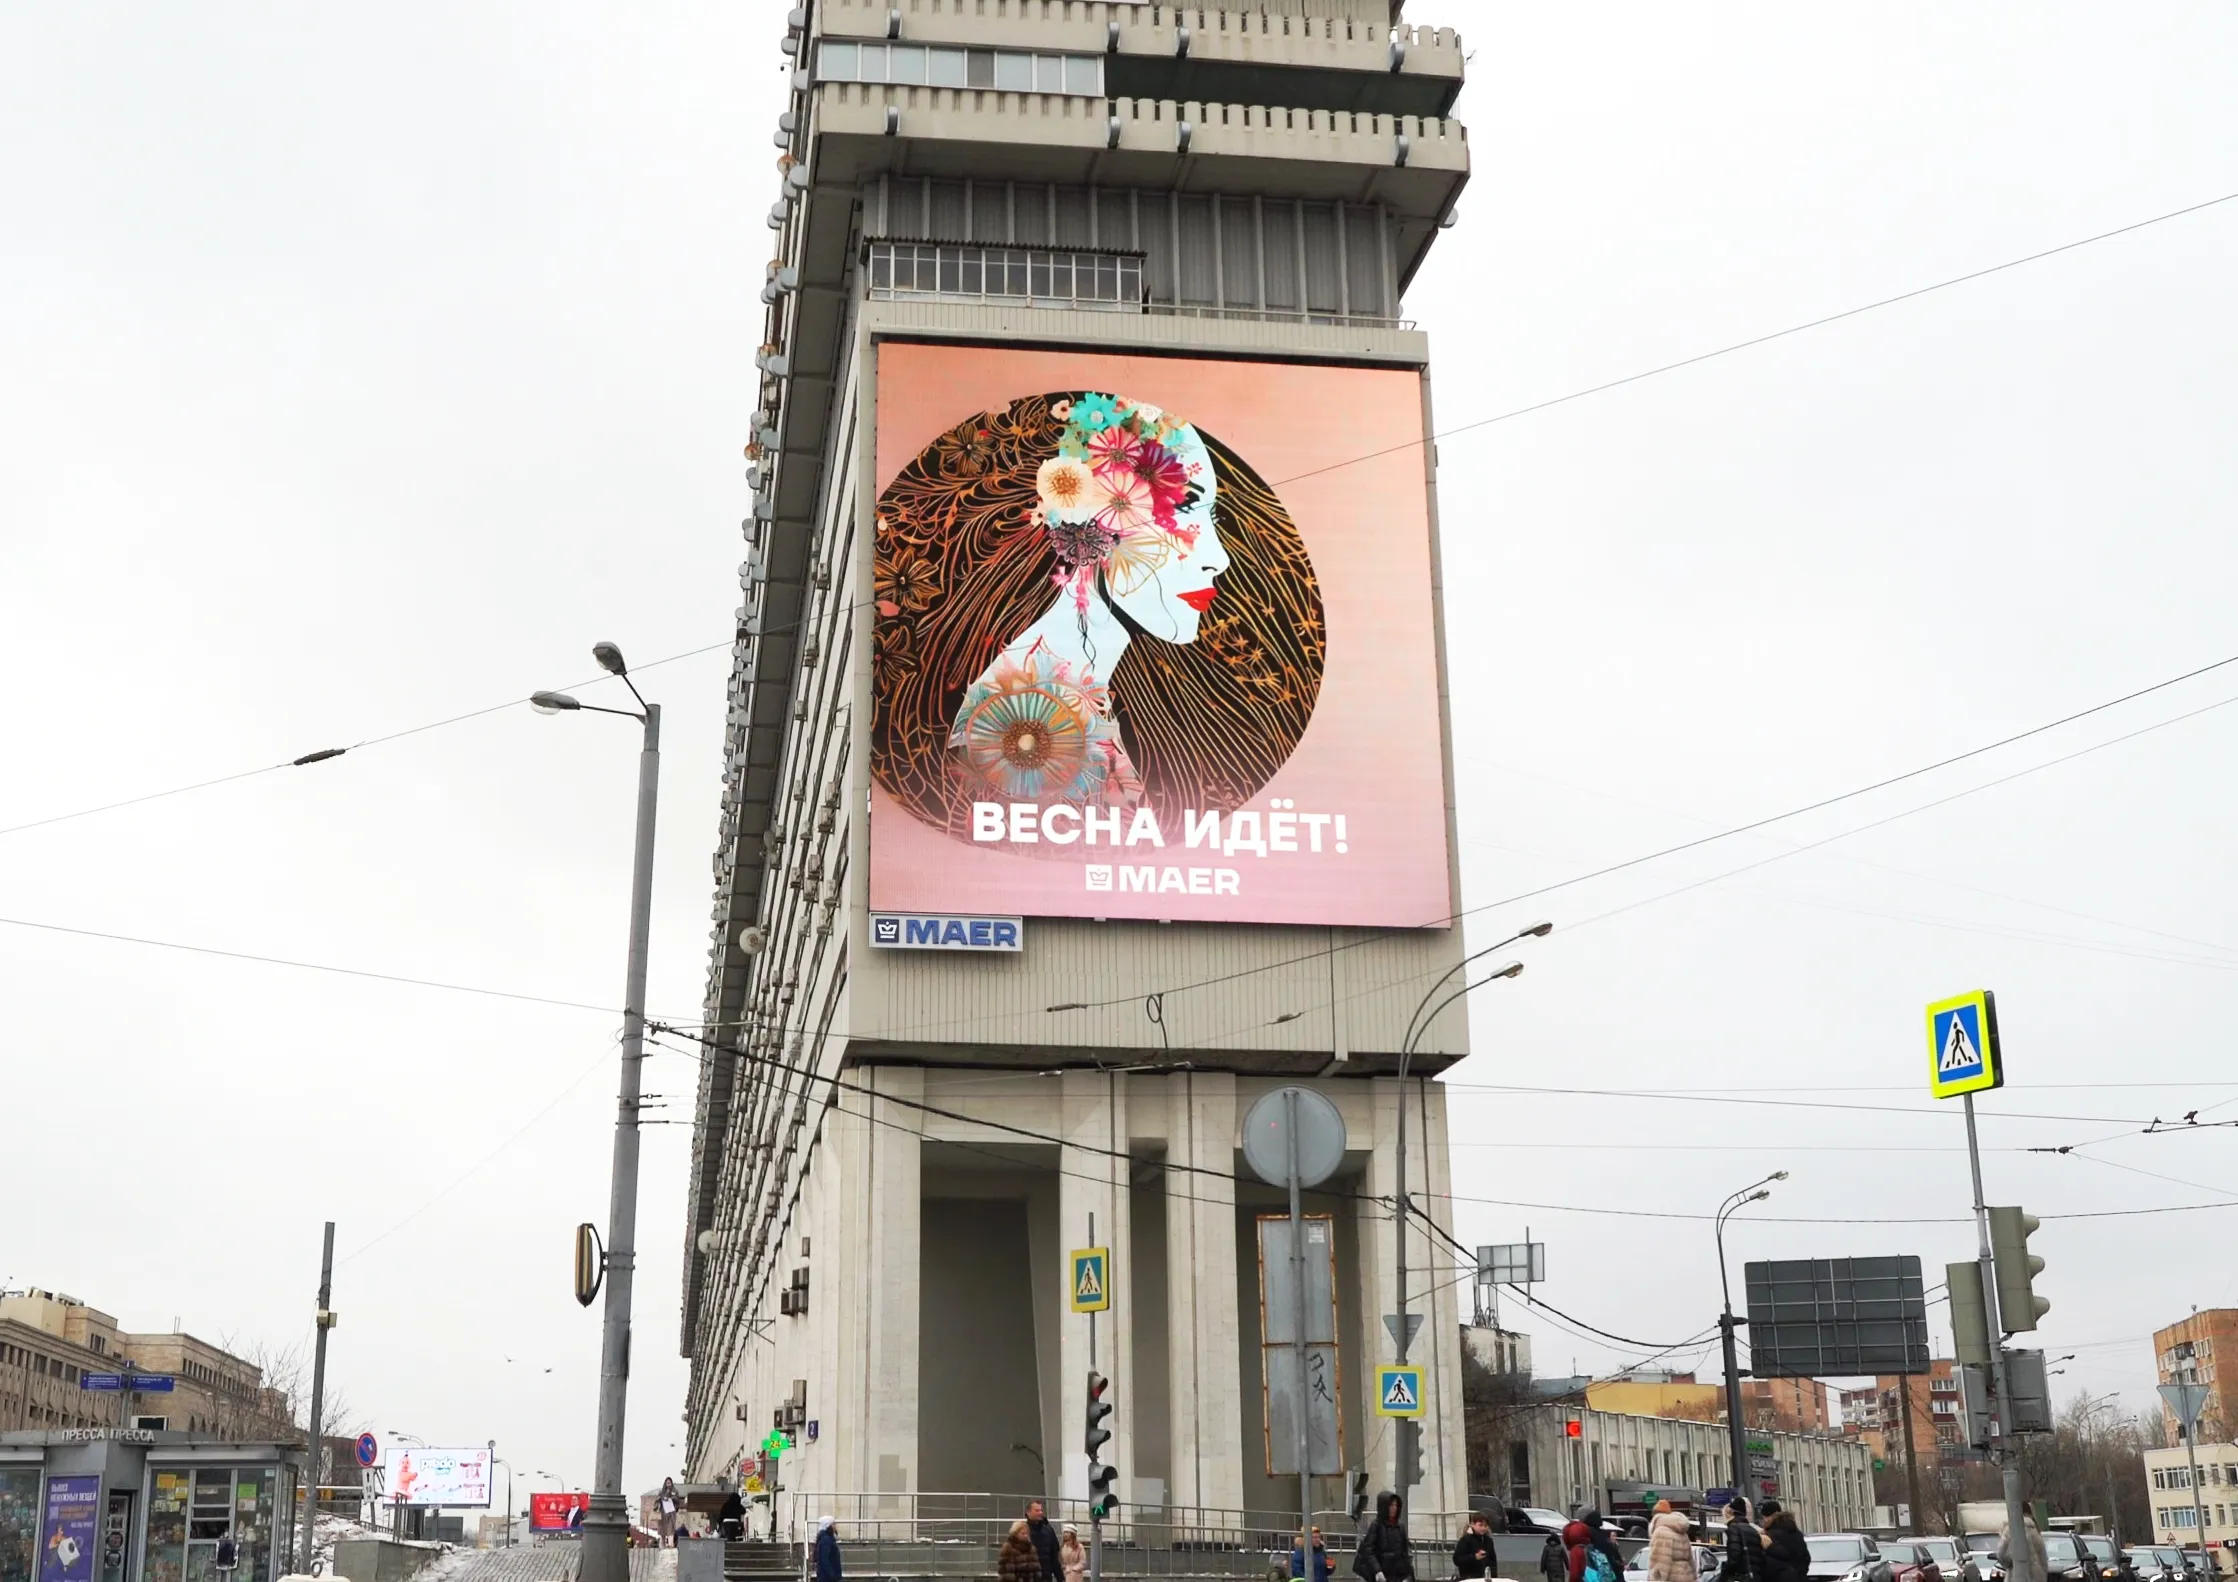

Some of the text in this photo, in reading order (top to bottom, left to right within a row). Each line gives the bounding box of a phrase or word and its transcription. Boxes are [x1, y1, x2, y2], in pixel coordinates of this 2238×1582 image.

[973, 798, 1349, 858] ВЕСНА ИДЁТ!
[1118, 864, 1241, 896] MAER
[905, 919, 1017, 947] MAER
[61, 1427, 105, 1441] ПРЕССА
[109, 1428, 155, 1442] ПРЕССА
